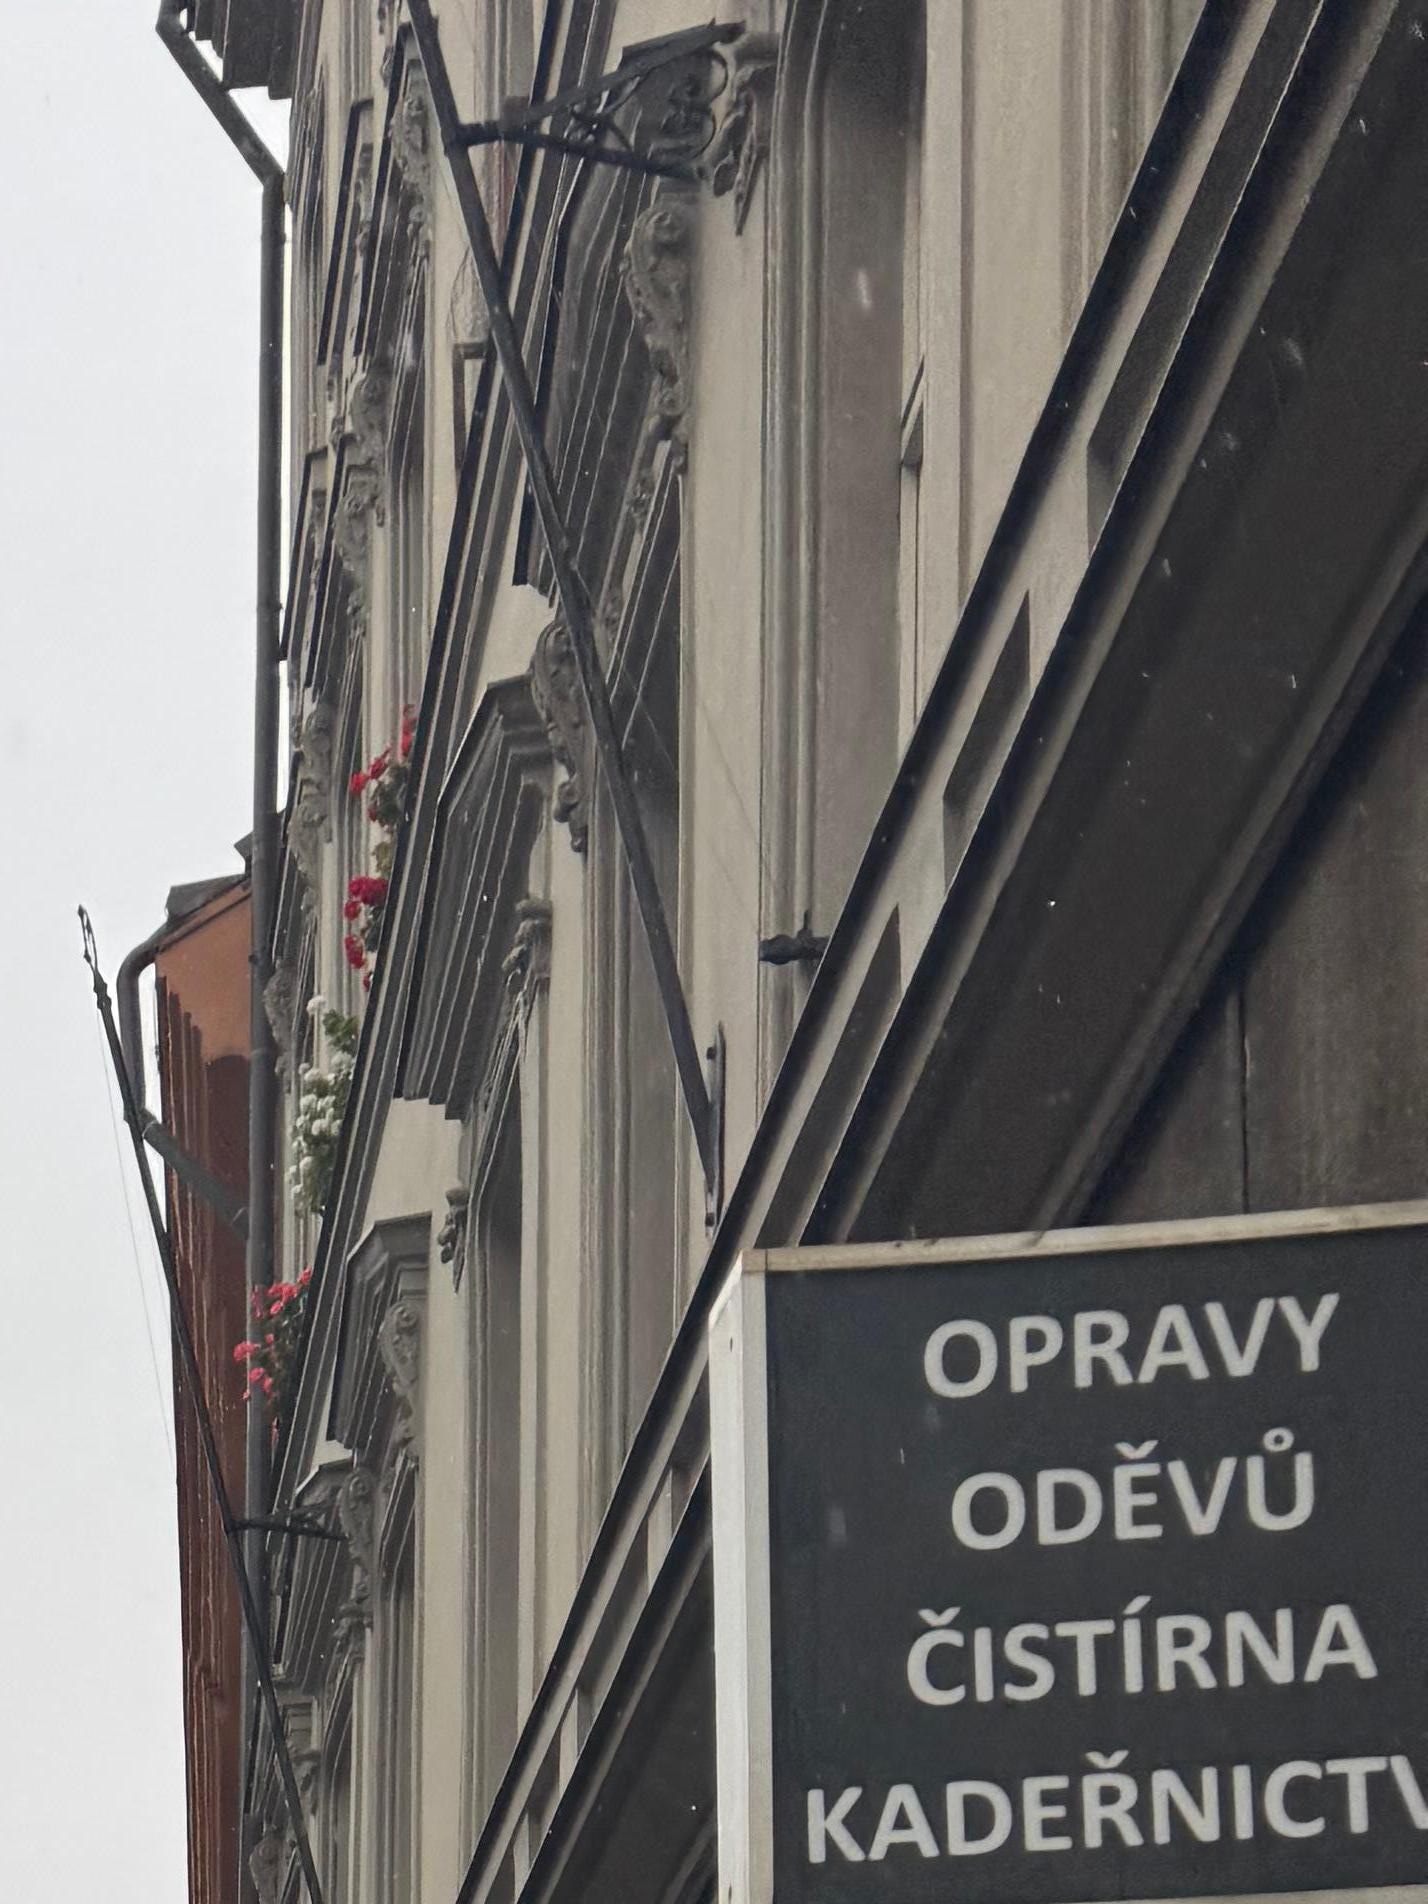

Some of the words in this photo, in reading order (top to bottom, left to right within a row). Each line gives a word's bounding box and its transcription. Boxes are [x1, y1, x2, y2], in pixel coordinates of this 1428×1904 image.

[923, 1292, 1341, 1398] OPRAVY
[950, 1427, 1316, 1552] ODĚVŮ
[906, 1594, 1378, 1706] ČISTÍRNA
